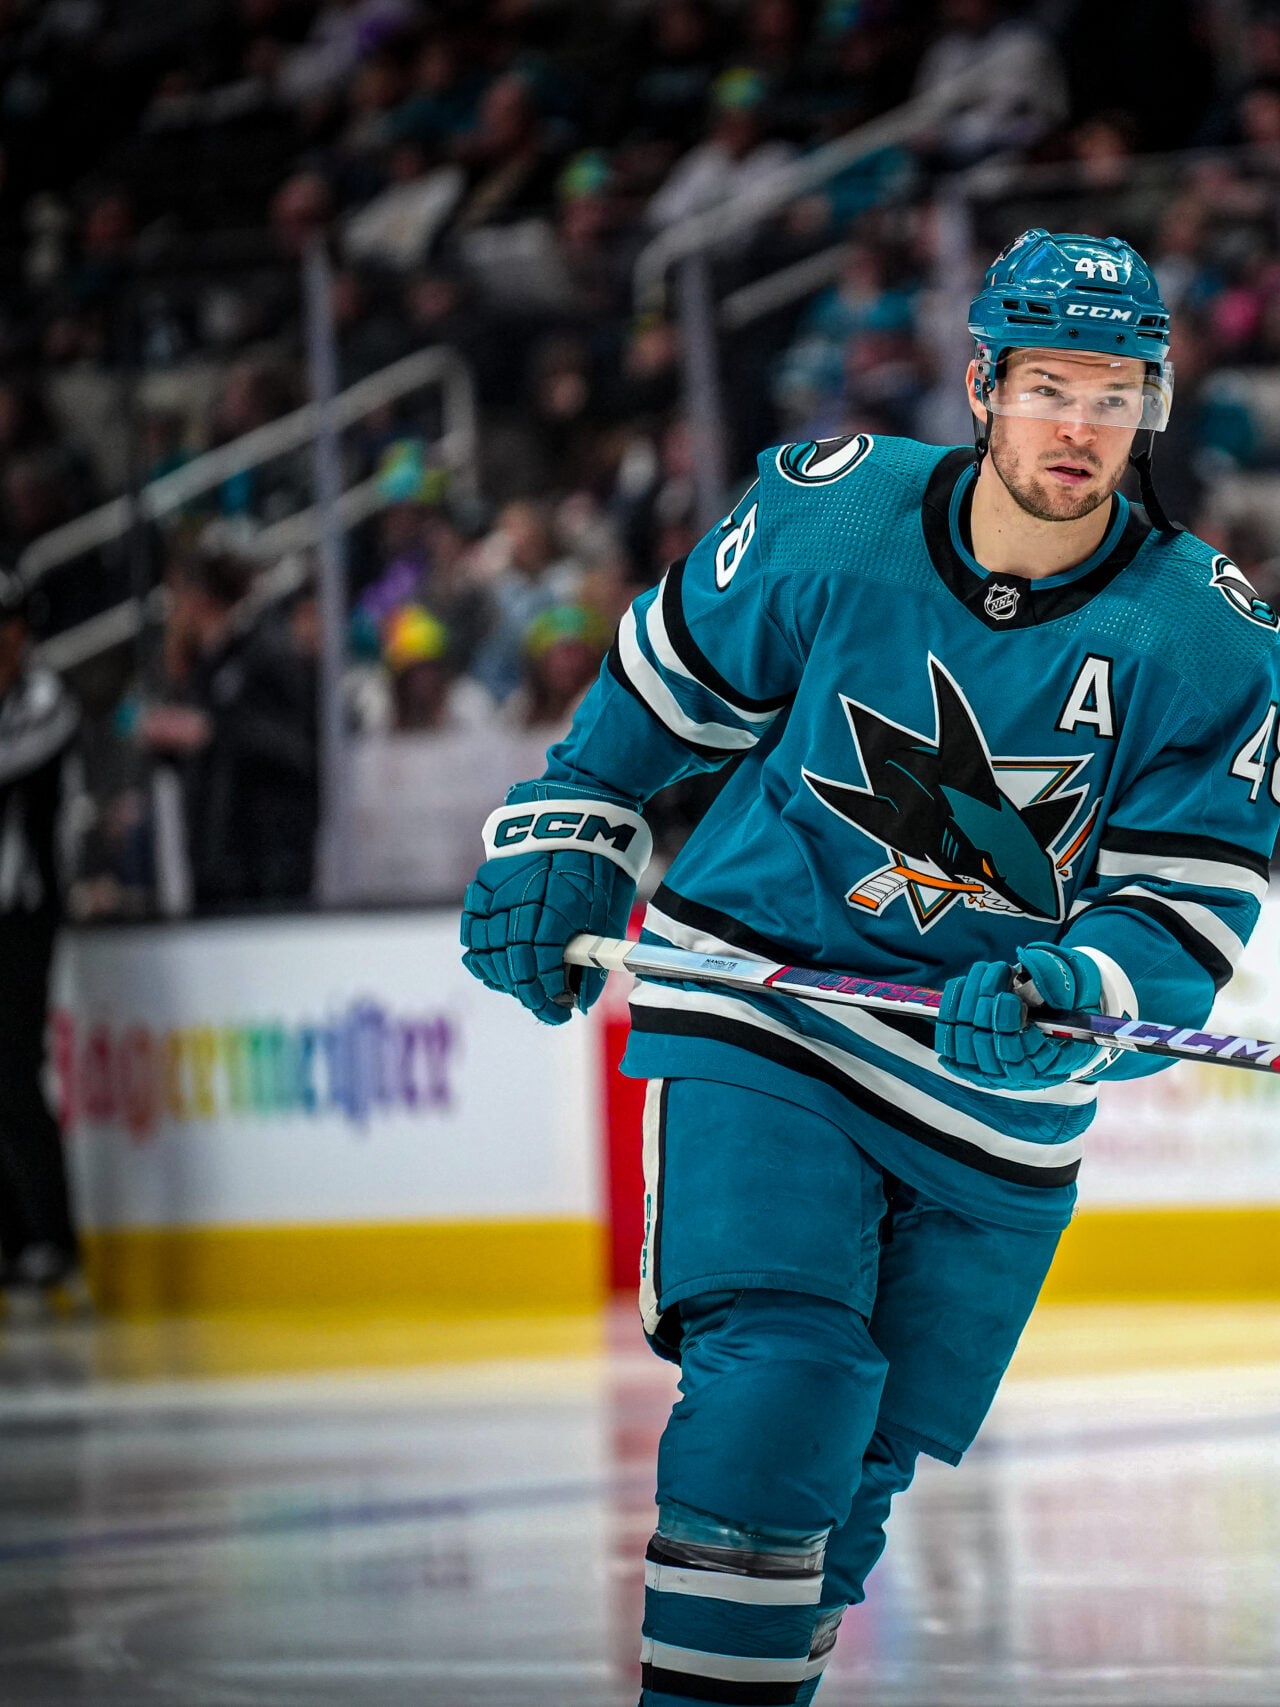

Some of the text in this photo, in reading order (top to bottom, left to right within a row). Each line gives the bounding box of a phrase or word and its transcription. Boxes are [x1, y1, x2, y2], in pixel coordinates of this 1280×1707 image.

[1065, 303, 1133, 321] CCM
[991, 595, 1013, 611] NHL
[1056, 653, 1116, 738] A
[493, 811, 638, 854] CCM
